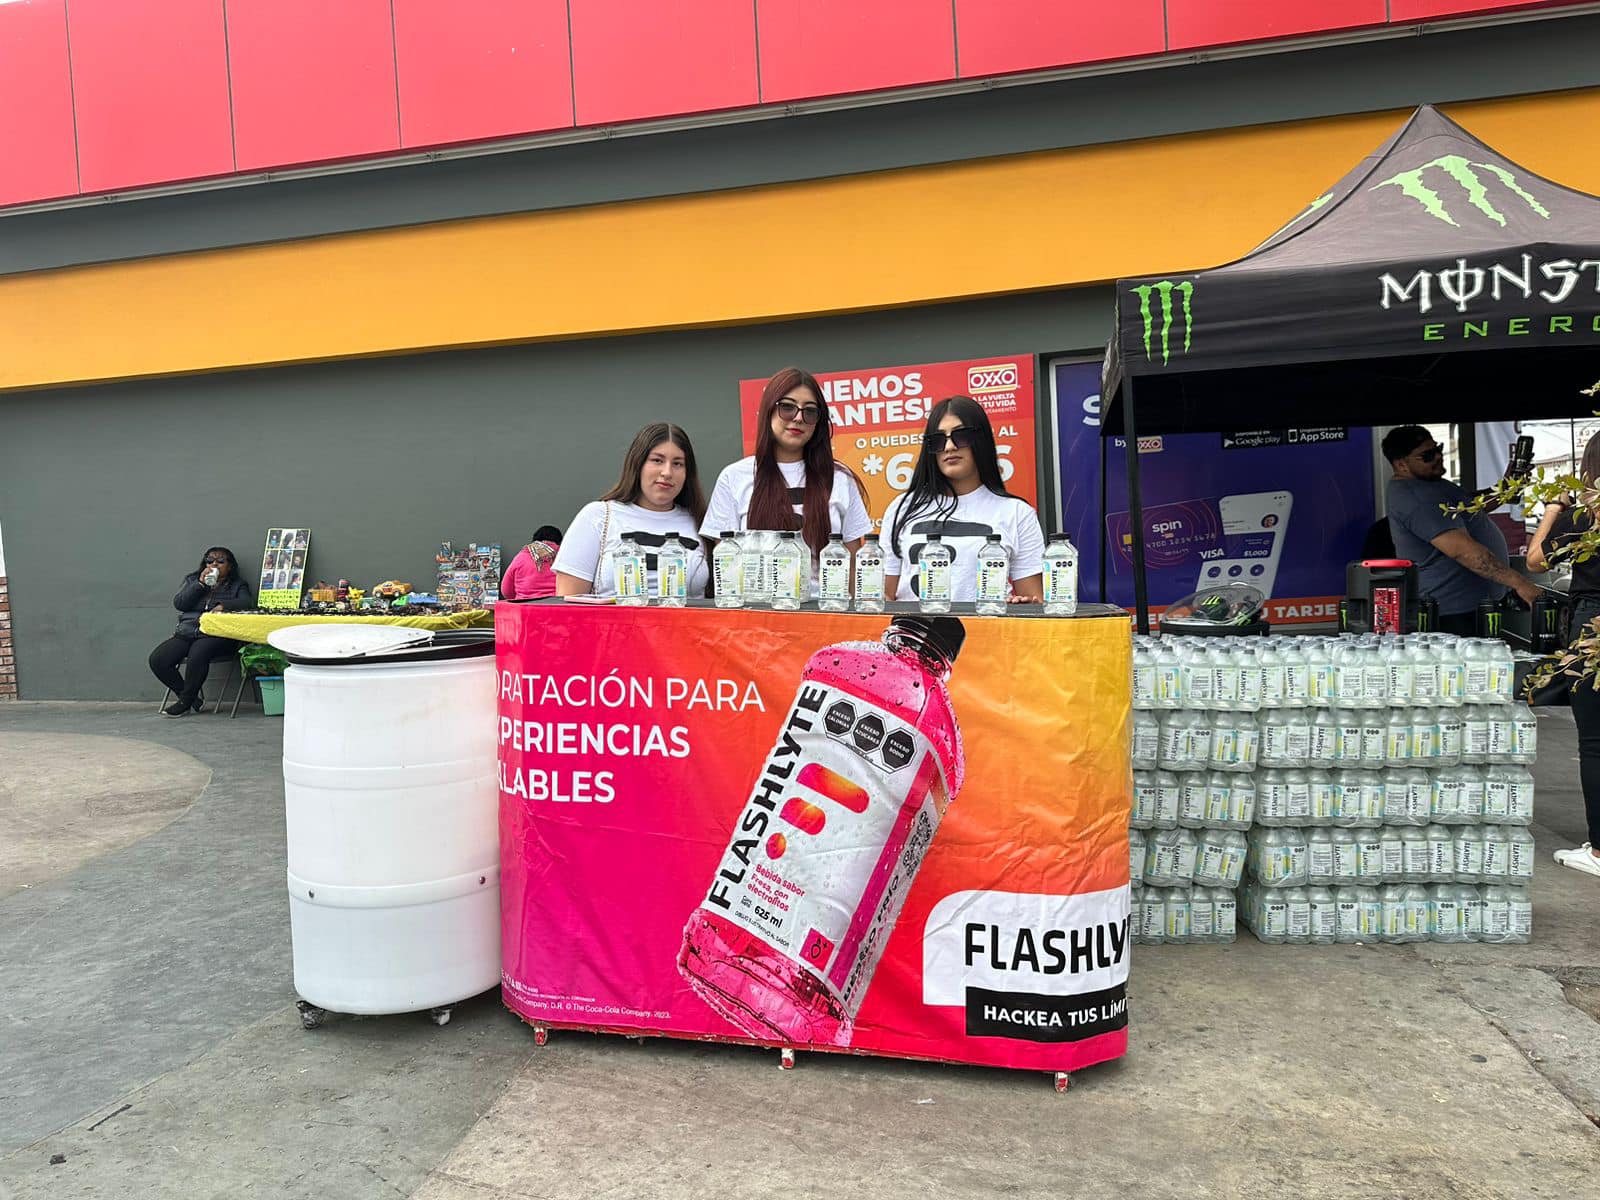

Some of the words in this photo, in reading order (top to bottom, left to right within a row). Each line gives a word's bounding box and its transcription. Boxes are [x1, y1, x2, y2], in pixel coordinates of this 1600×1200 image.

[970, 368, 1016, 390] OXXO
[988, 393, 1016, 401] VUELTA
[996, 399, 1016, 407] VIDA
[855, 437, 868, 449] O
[998, 425, 1018, 438] AL
[1137, 438, 1161, 450] XXO
[1235, 433, 1263, 447] Google
[1299, 432, 1316, 443] App
[1316, 428, 1345, 440] Store
[1151, 518, 1183, 534] spin
[1199, 547, 1225, 560] VISA
[714, 558, 722, 595] FLASHLYTE
[665, 676, 766, 713] PARA
[708, 685, 828, 910] FLASHLYTE
[751, 873, 773, 894] Fresa,
[773, 889, 790, 900] con
[755, 863, 783, 885] Bebida
[782, 879, 806, 898] sabor
[754, 905, 770, 921] 625
[769, 915, 784, 929] ml
[573, 1003, 585, 1012] The
[585, 1004, 620, 1015] Coca-Cola
[983, 1005, 1063, 1027] HACKEA
[1068, 1008, 1098, 1027] TUS
